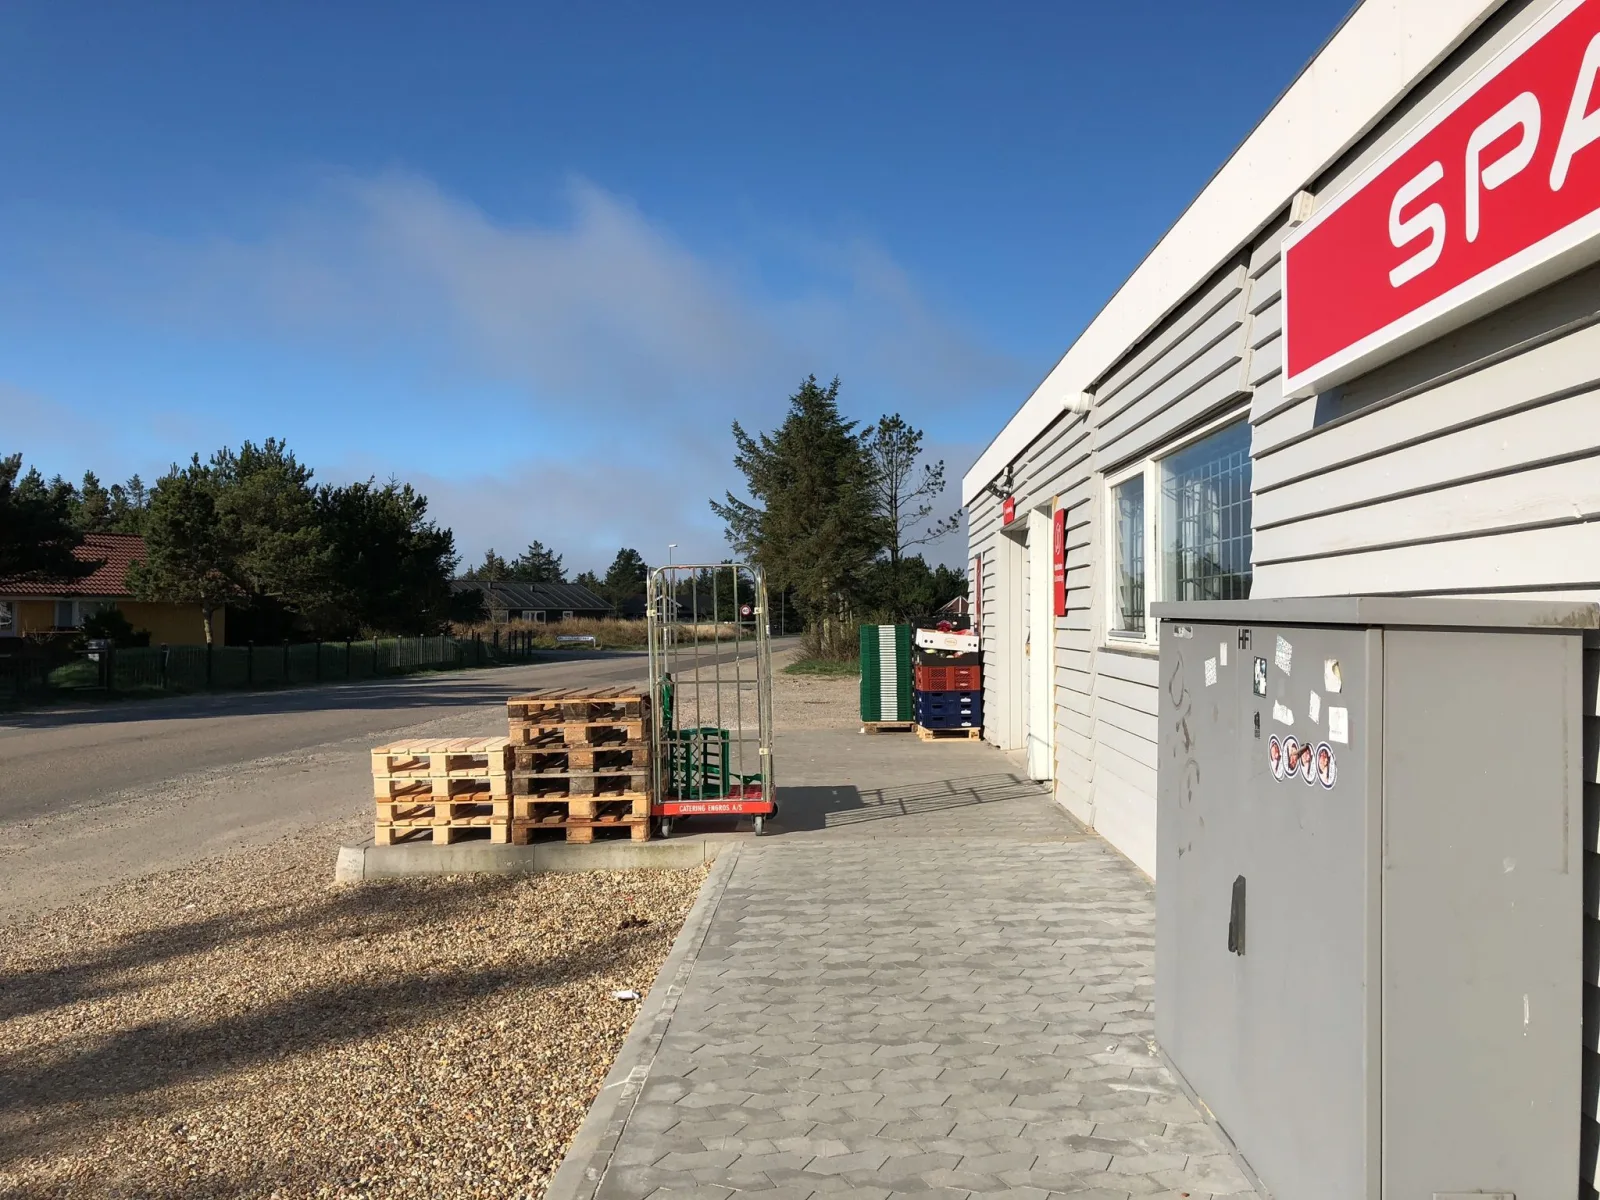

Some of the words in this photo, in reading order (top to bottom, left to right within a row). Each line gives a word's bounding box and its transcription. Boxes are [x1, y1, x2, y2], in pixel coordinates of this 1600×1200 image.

[679, 804, 705, 812] CATERING
[708, 803, 729, 811] ENGROS
[732, 803, 743, 811] A/S
